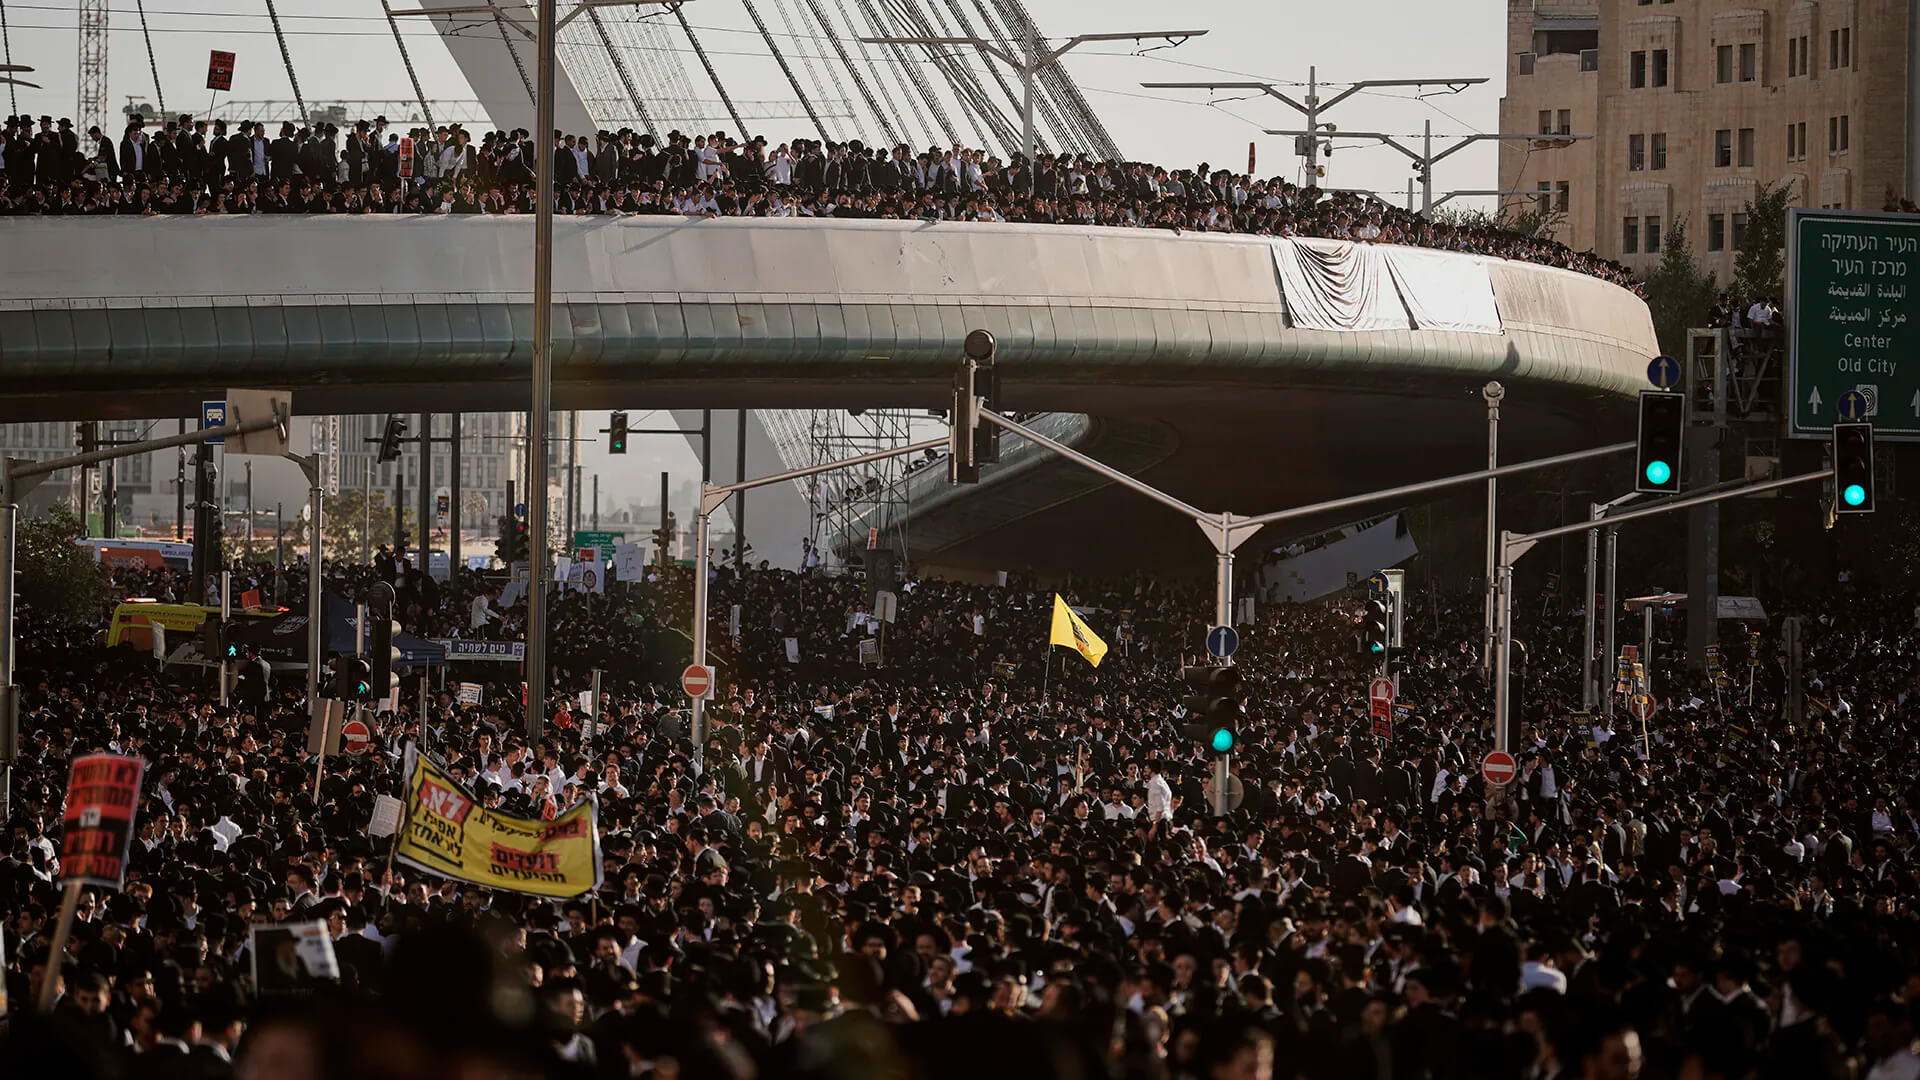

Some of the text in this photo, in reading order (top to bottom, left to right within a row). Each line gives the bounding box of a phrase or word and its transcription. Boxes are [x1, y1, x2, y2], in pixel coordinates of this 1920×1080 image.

[1821, 233, 1918, 254] העיר העתיקה
[1831, 258, 1907, 276] מרכז העיר
[1828, 281, 1906, 301] البلدة القديمة
[1828, 306, 1907, 328] مركز المدينة
[1844, 333, 1892, 349] Center
[1838, 357, 1897, 376] Old City
[458, 642, 487, 653] לשתיה
[489, 643, 506, 654] מים
